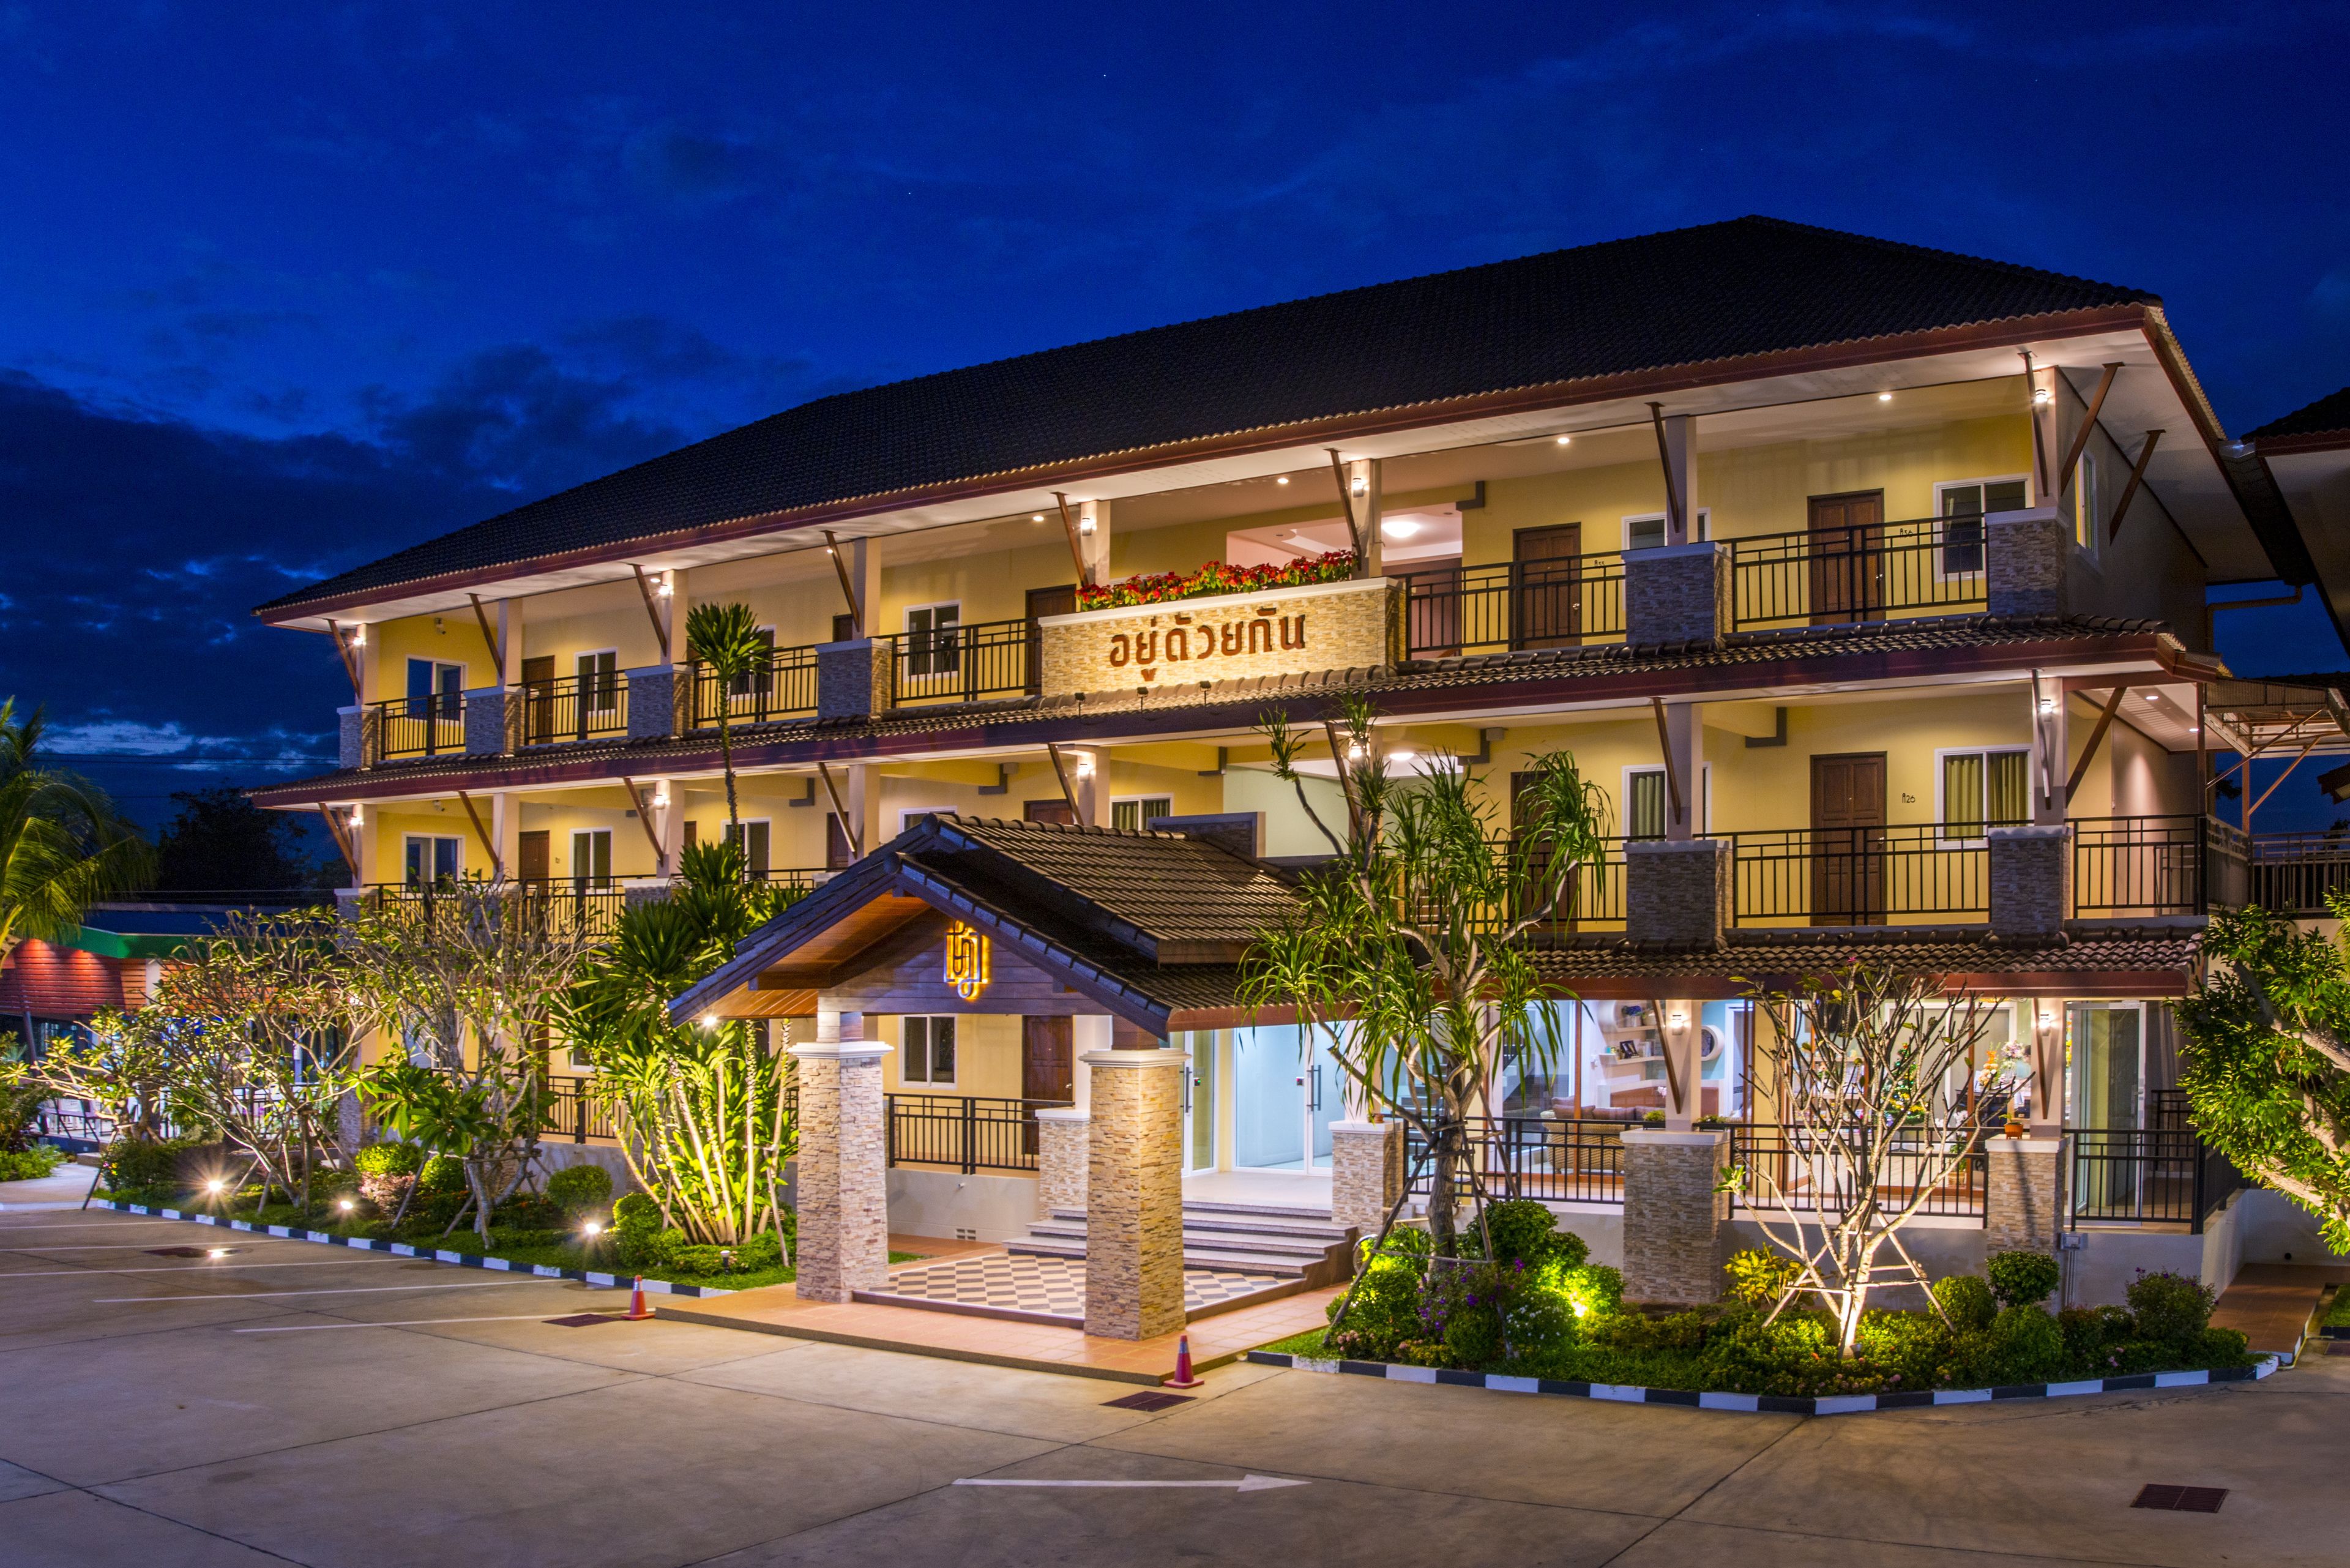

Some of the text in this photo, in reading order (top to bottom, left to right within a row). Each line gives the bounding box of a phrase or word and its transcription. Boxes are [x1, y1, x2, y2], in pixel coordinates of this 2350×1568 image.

[1110, 607, 1305, 682] อยู่ด้วยกัน
[1902, 793, 1915, 803] A26
